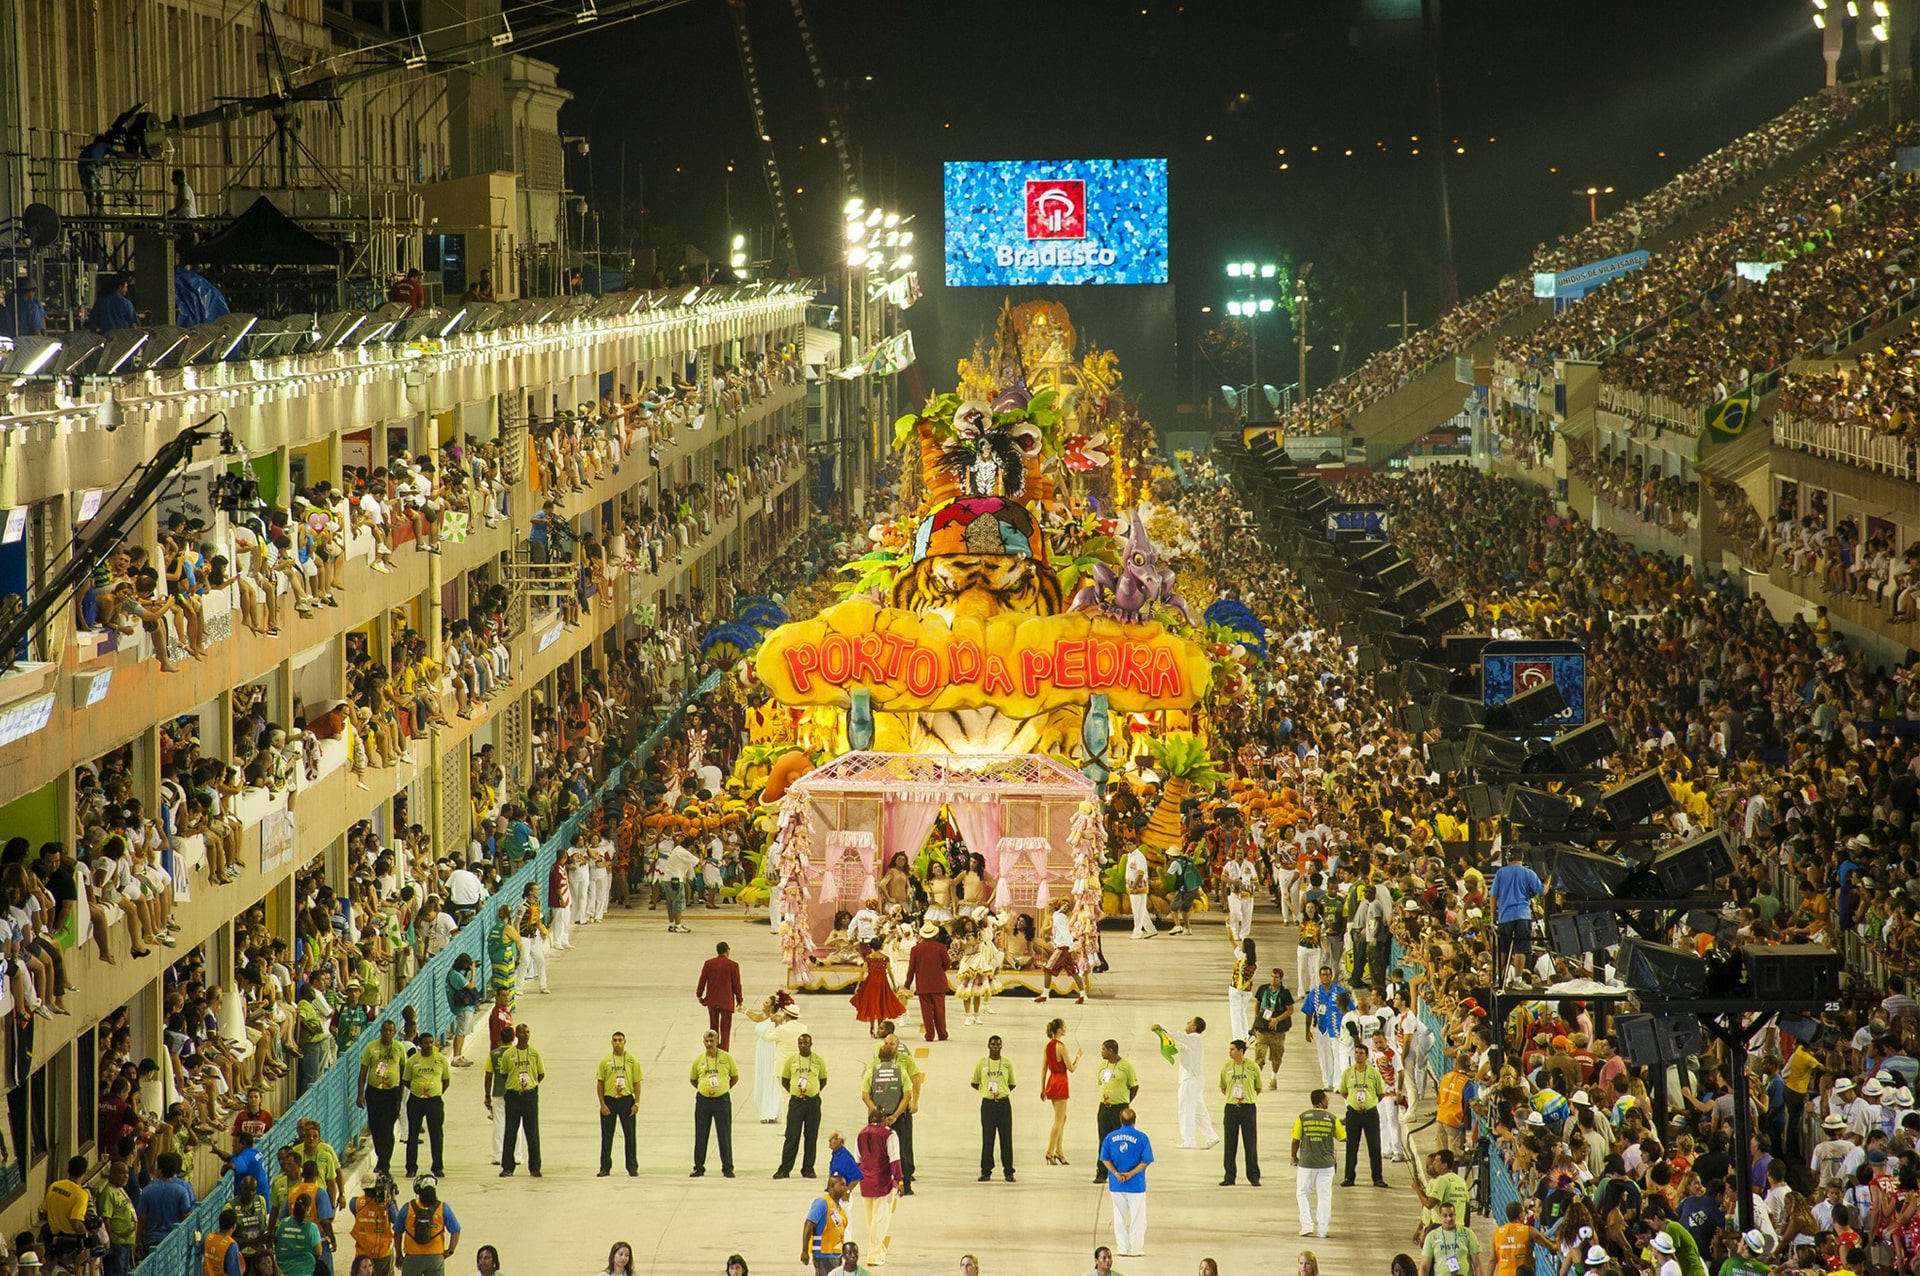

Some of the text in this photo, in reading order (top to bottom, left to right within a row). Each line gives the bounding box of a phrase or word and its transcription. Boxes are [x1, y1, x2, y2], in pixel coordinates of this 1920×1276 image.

[997, 243, 1115, 267] Bradesco
[1558, 256, 1643, 286] UNIDOS DE VILA ISABEL
[784, 631, 1182, 698] PORTO DA PEDRA
[1605, 774, 1617, 782] 22
[1659, 832, 1672, 840] 23
[1722, 901, 1736, 910] 24
[1825, 1002, 1840, 1011] 25
[1550, 1112, 1559, 1120] 10
[1112, 1133, 1137, 1144] DIRETORIA
[1440, 1243, 1460, 1251] PISTA
